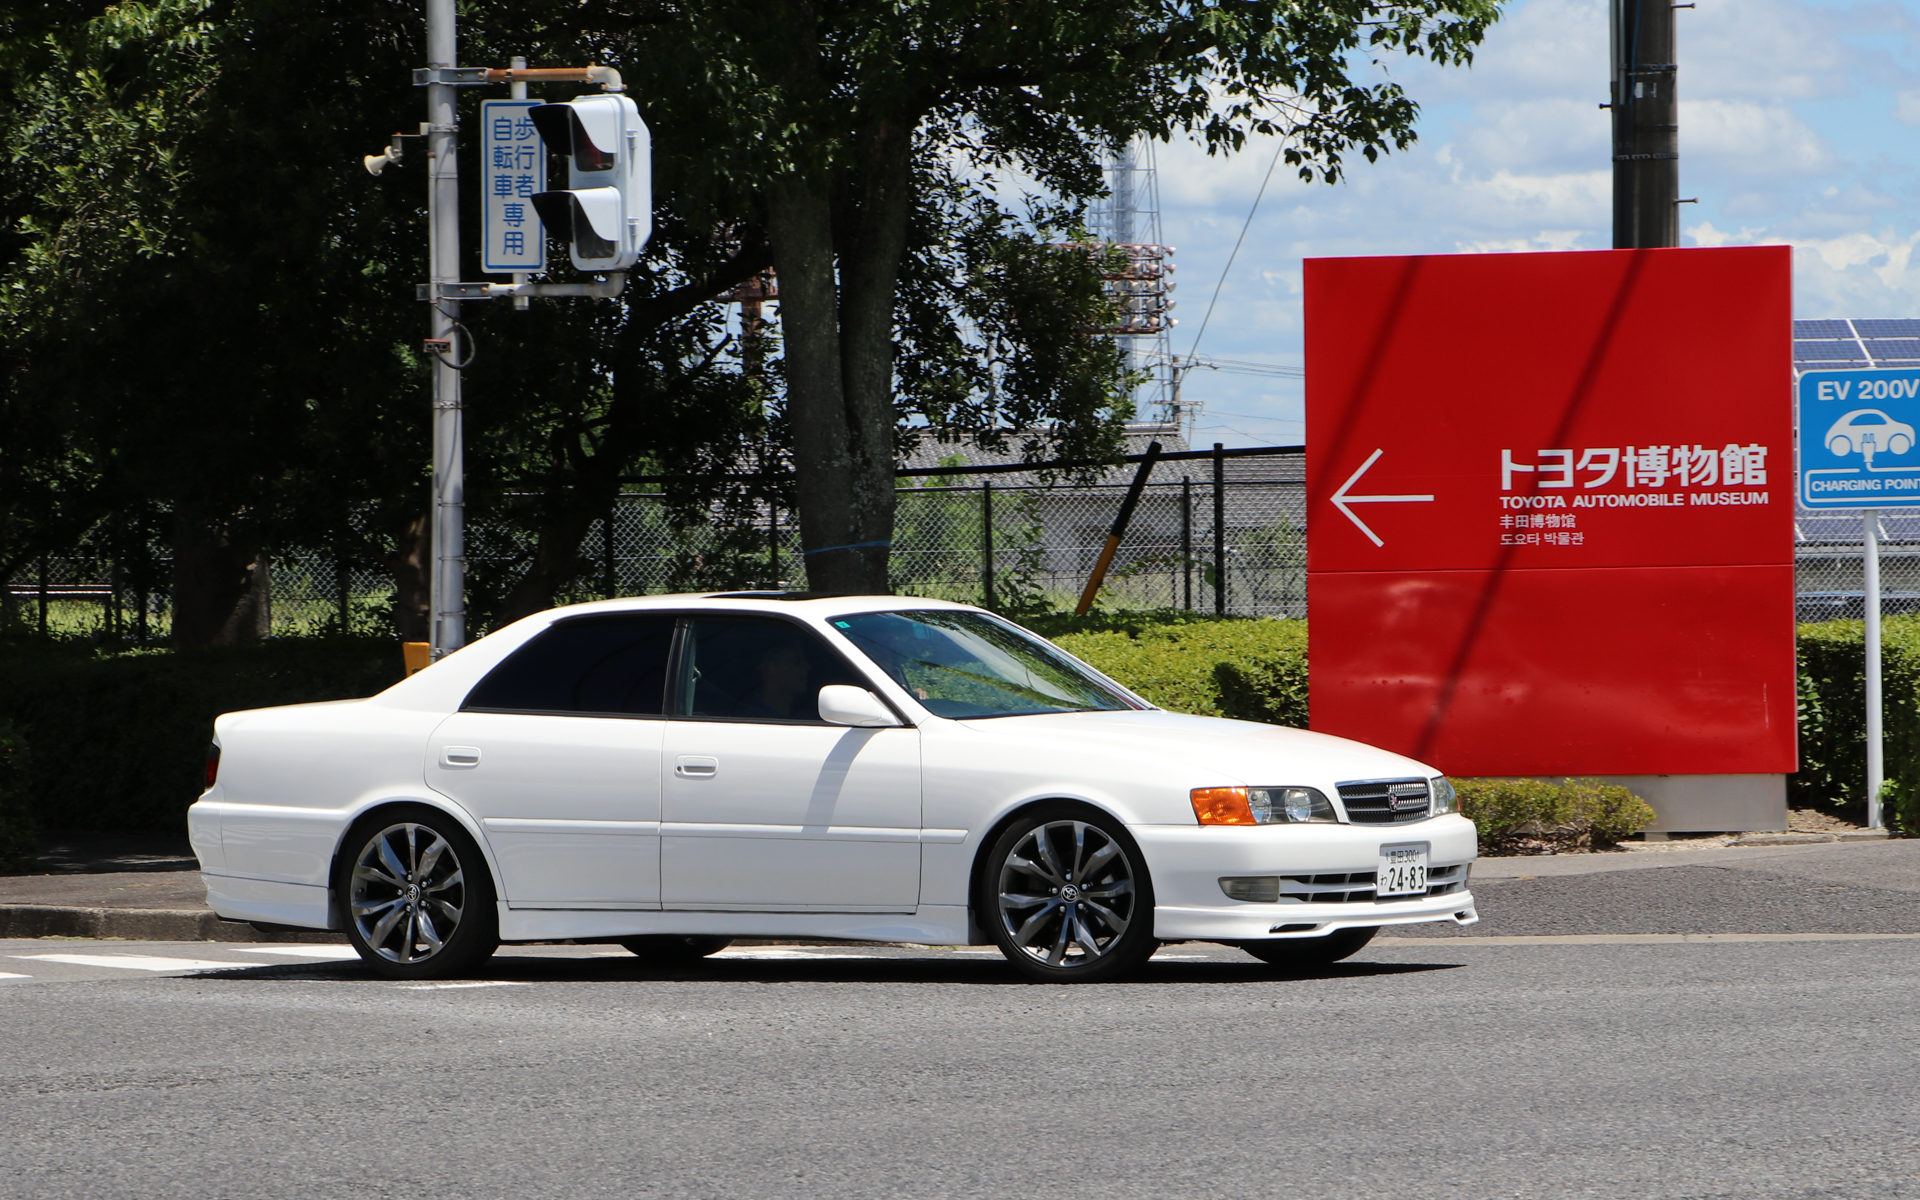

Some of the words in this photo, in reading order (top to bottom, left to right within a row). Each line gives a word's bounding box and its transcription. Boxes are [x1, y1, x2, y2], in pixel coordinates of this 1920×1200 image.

[493, 117, 513, 199] 自転車
[514, 116, 536, 199] 歩行者
[502, 203, 526, 256] 専用
[1817, 380, 1851, 401] EV
[1857, 378, 1920, 400] 200V
[1500, 443, 1769, 490] トヨタ博物館
[1811, 479, 1882, 492] CHARGING
[1500, 495, 1567, 509] TOYOTA
[1572, 493, 1685, 508] AUTOMOBILE
[1690, 491, 1769, 506] MUSEUM
[1499, 513, 1577, 529] 丰田博物馆
[1500, 533, 1541, 546] 도요타
[1543, 532, 1585, 546] 박물관
[1388, 865, 1425, 891] 24-83
